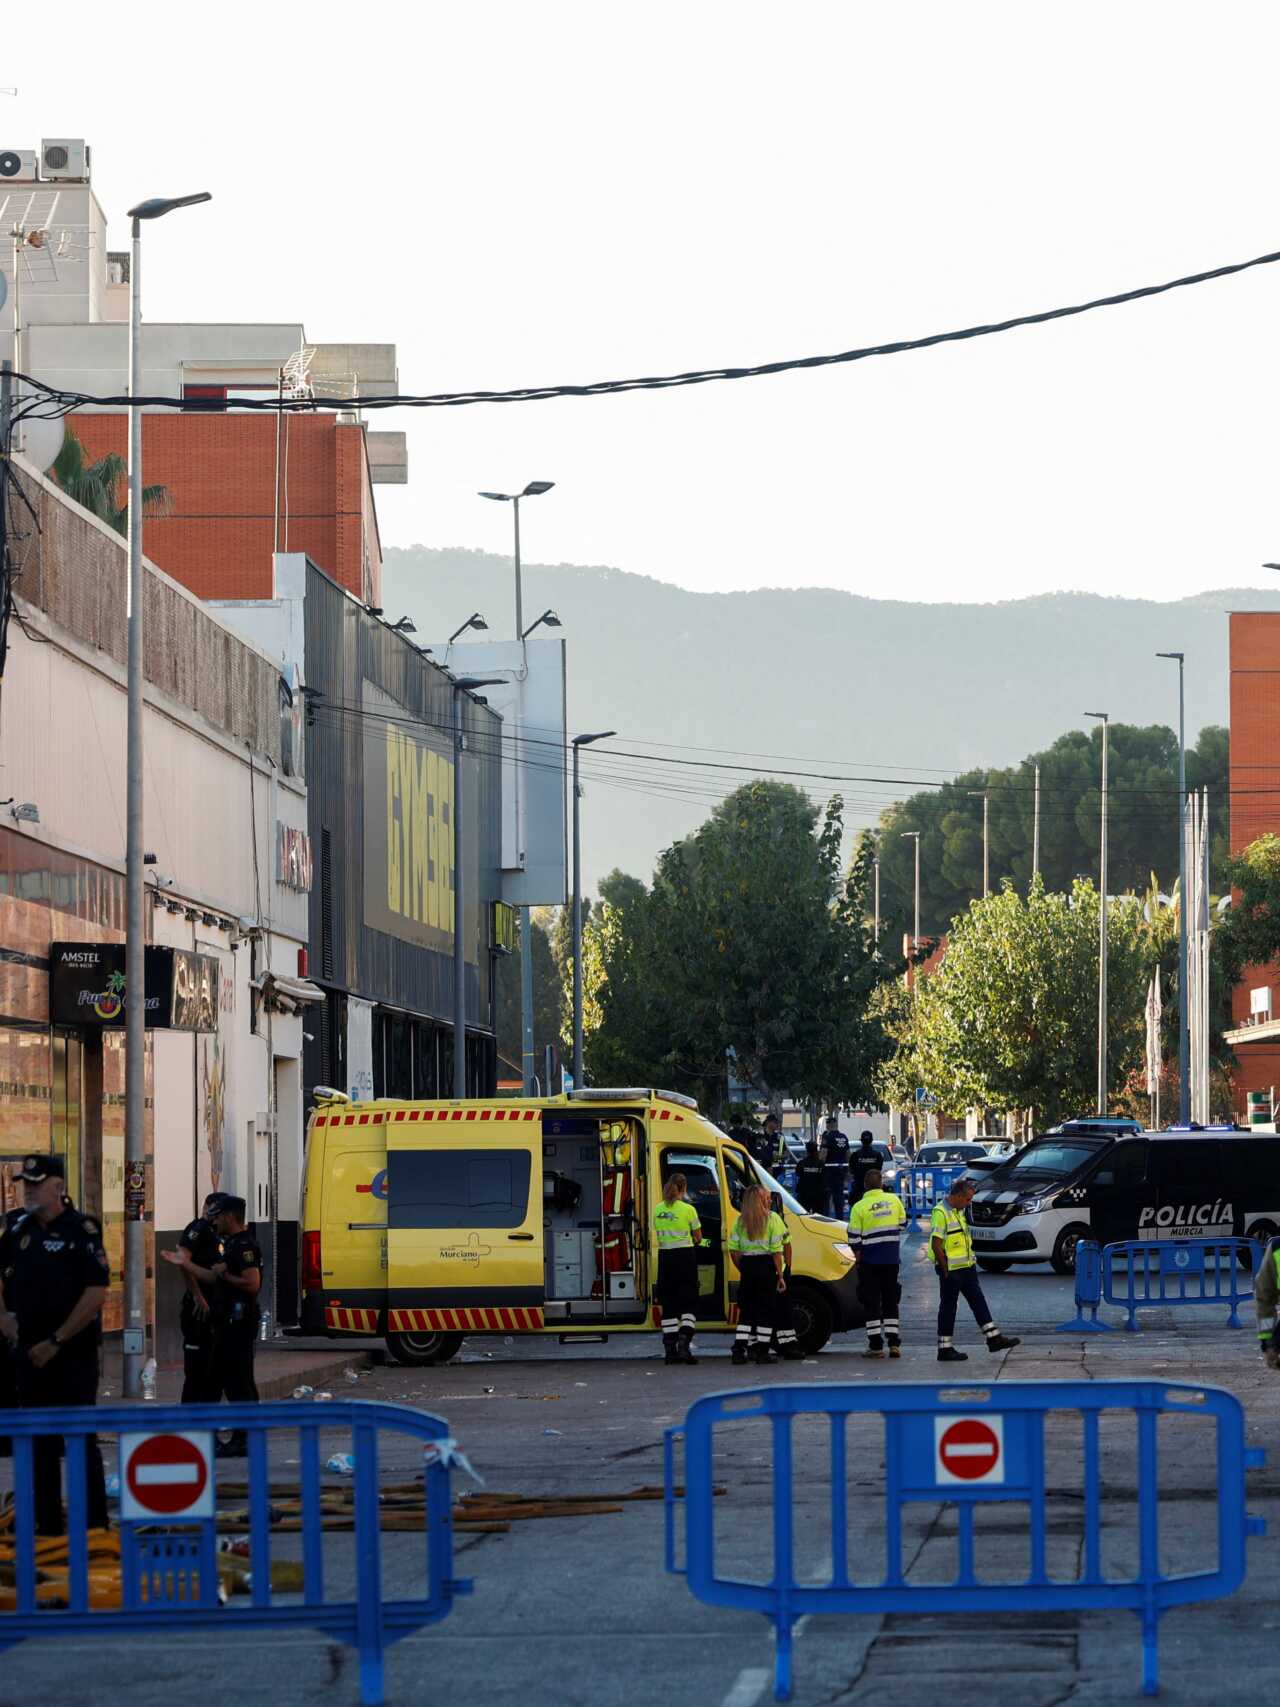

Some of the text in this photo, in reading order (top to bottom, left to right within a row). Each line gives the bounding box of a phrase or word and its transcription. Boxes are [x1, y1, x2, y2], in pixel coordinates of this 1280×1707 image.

[61, 951, 101, 963] AMSTEL
[1139, 1198, 1234, 1228] POLICÍA
[1169, 1226, 1204, 1237] MURCIA
